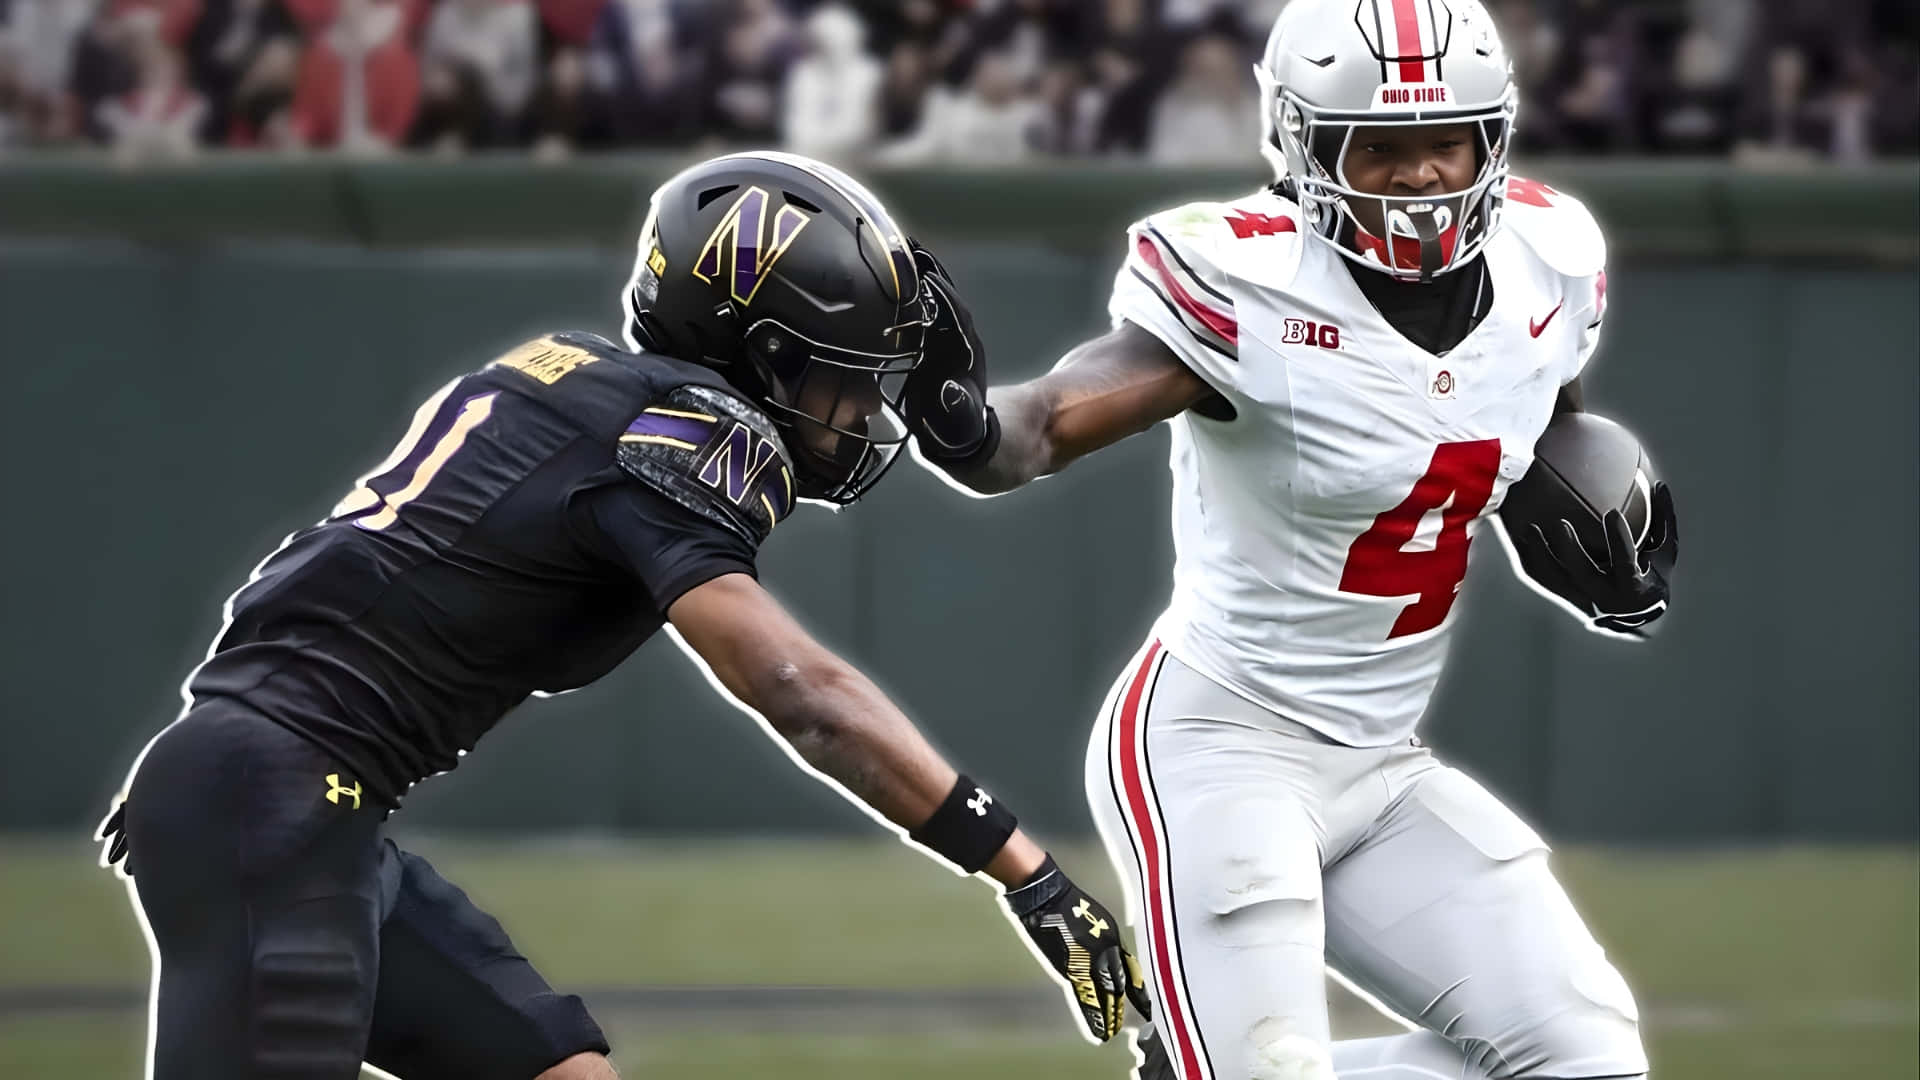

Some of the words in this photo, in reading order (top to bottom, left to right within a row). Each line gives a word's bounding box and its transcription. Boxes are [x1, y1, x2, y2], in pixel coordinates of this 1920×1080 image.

[1382, 89, 1410, 104] OHIO
[1414, 88, 1446, 103] STATE
[692, 185, 811, 307] N
[697, 422, 777, 506] N
[1337, 438, 1502, 641] 4
